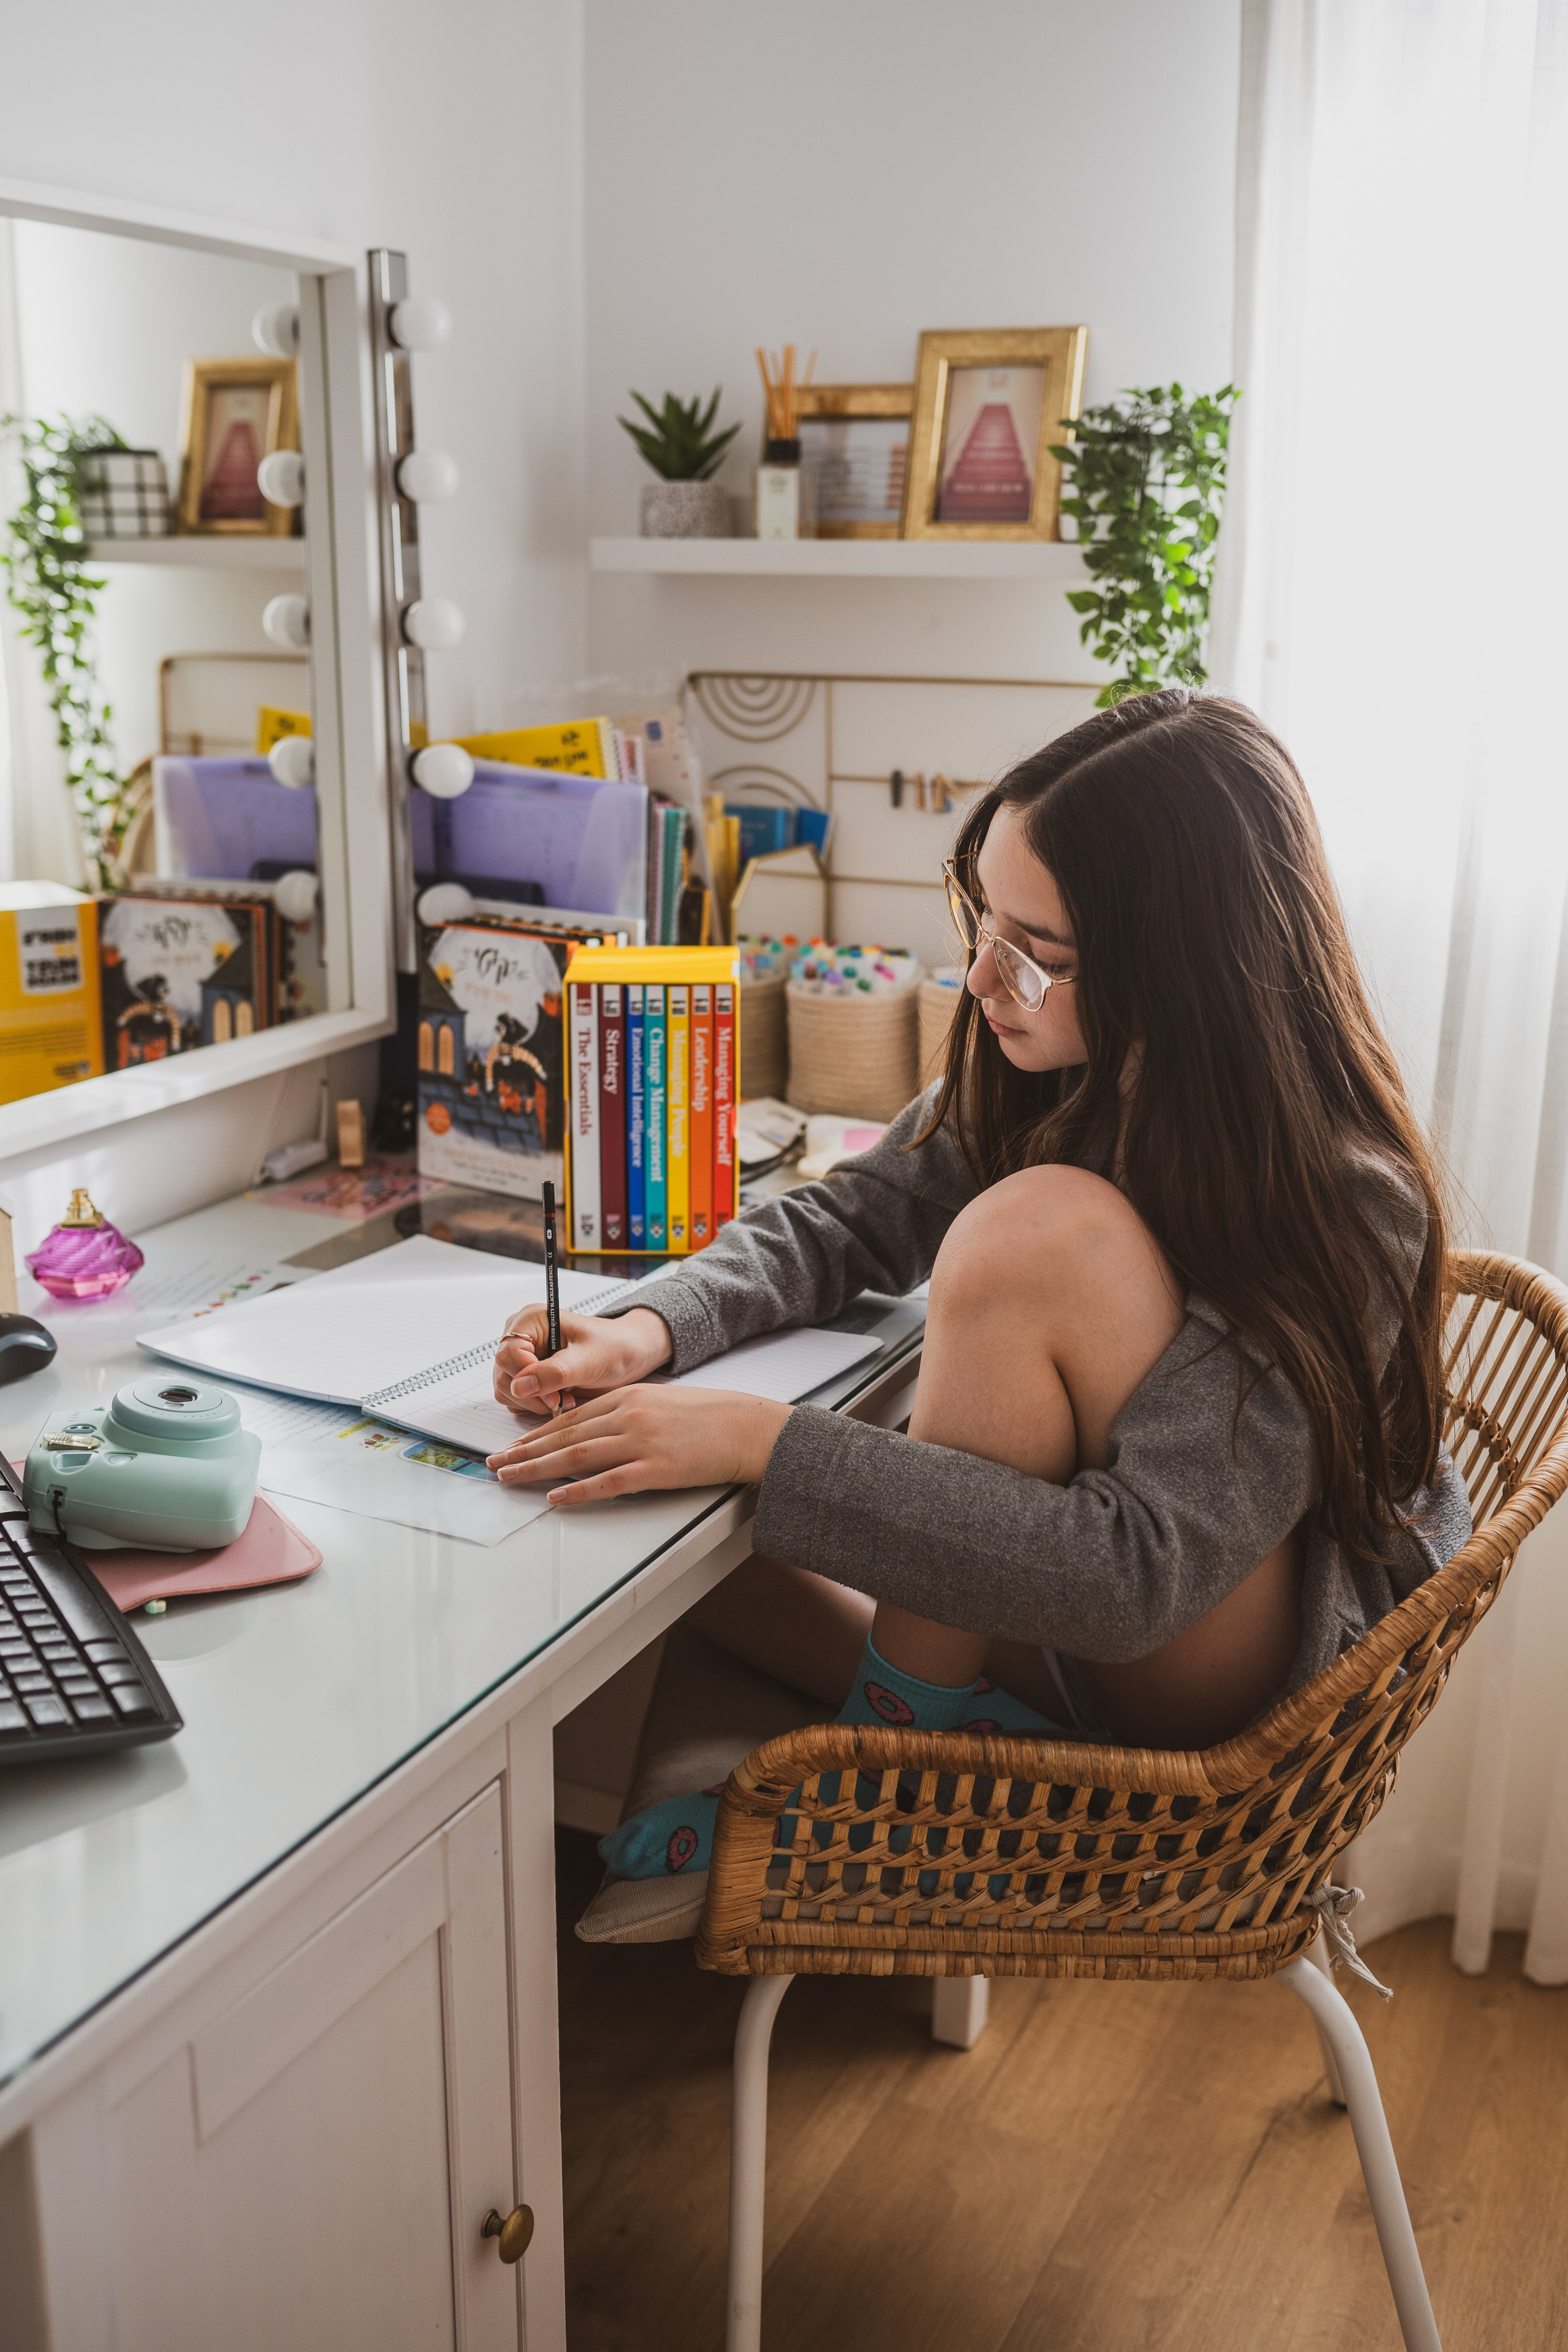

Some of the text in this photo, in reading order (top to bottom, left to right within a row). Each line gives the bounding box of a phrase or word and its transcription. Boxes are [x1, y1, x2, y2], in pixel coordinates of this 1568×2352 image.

[578, 1028, 592, 1058] The
[603, 1029, 620, 1095] Strategy
[631, 1027, 644, 1093] Emotional
[648, 1027, 664, 1084] Change
[669, 1029, 686, 1104] Managing
[692, 1027, 709, 1112] Leadership
[715, 1027, 731, 1099] Managing
[578, 1061, 593, 1136] Essentials
[630, 1095, 643, 1168] Intelligence
[669, 1107, 686, 1158] People
[648, 1087, 664, 1182] Management
[717, 1103, 731, 1166] Yourself
